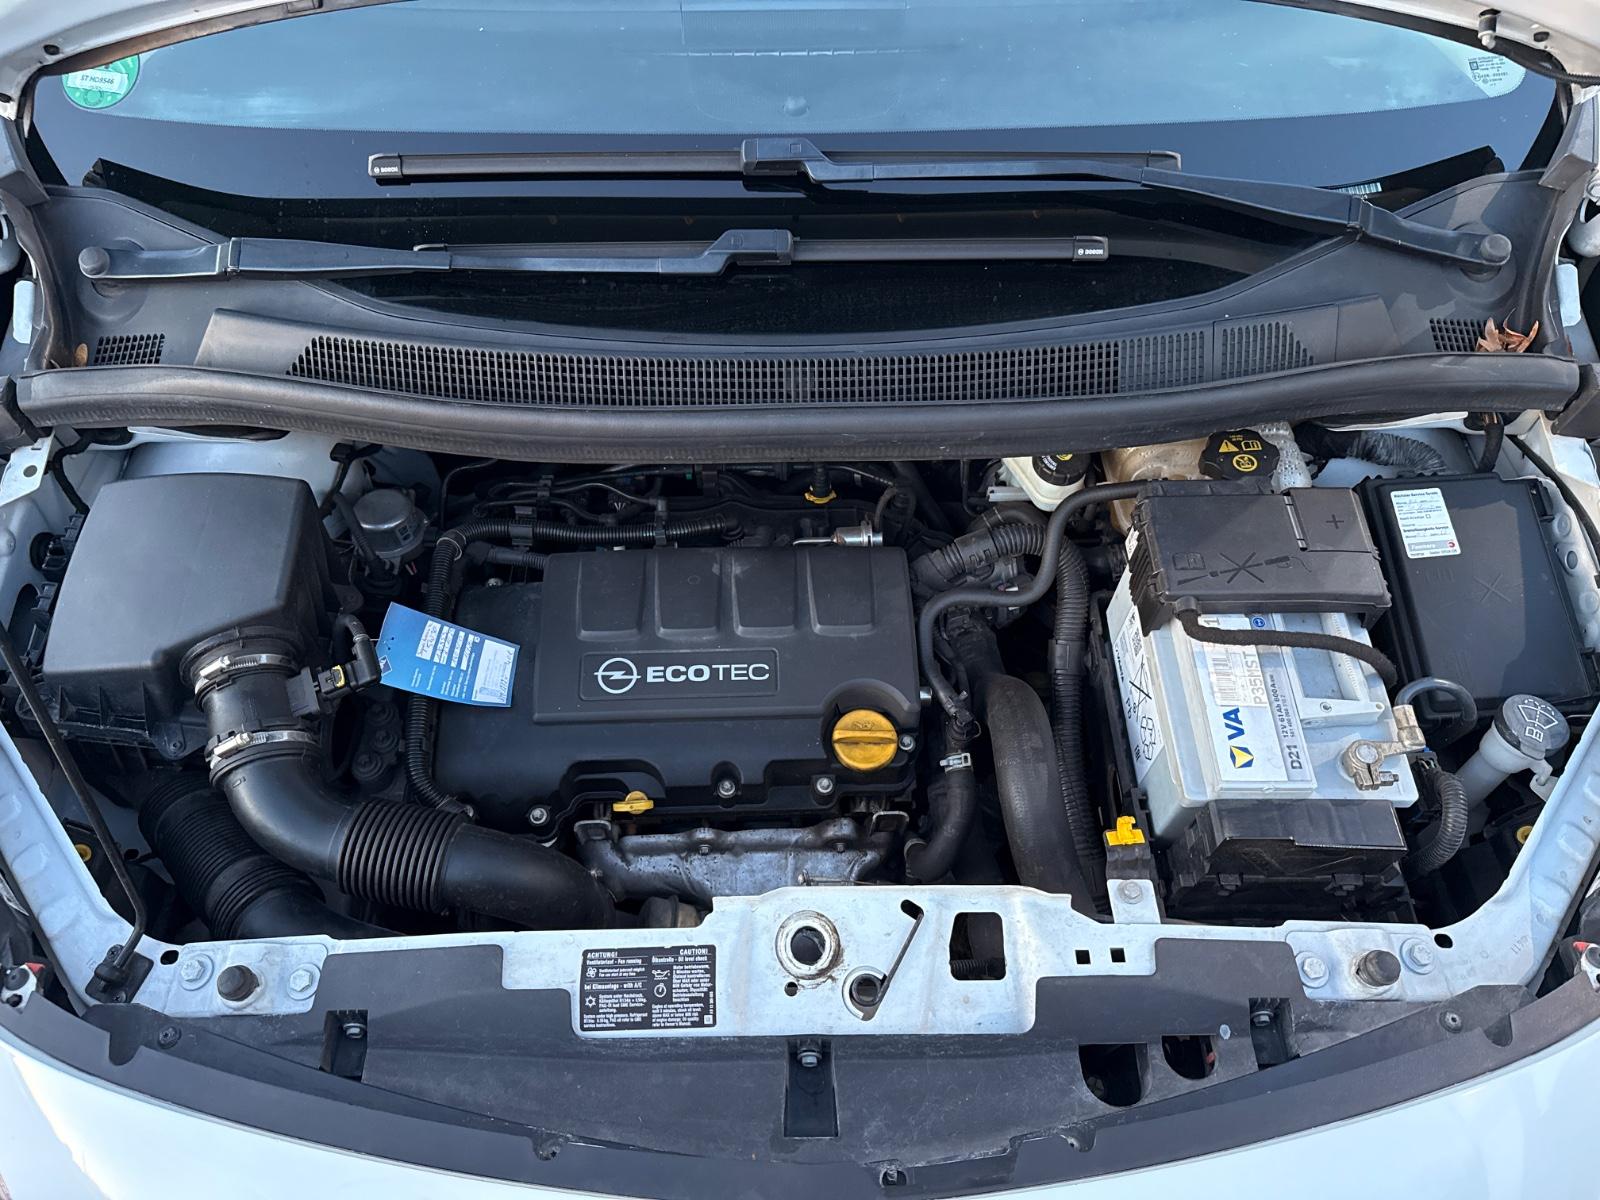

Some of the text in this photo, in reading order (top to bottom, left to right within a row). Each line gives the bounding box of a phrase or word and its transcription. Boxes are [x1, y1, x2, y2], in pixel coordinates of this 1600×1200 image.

[646, 663, 770, 683] ECOTEC
[1243, 651, 1268, 704] P35MST
[1275, 703, 1286, 723] 61Ah
[1280, 724, 1289, 738] 12V
[1286, 744, 1303, 770] D21
